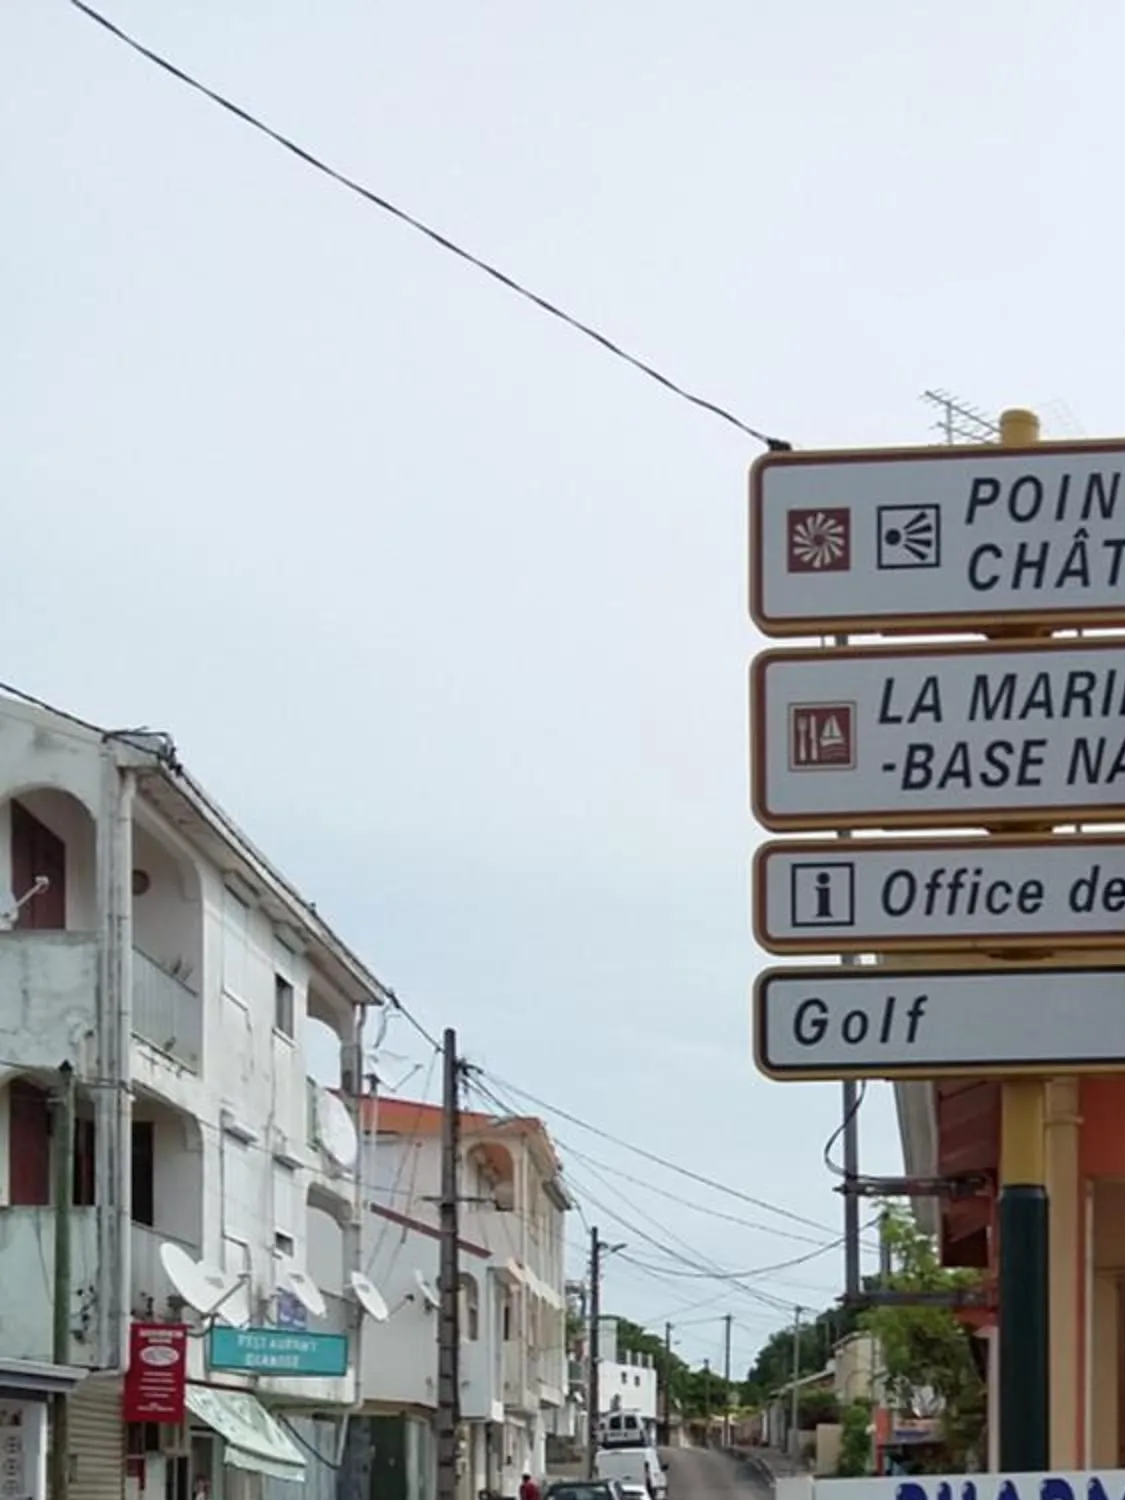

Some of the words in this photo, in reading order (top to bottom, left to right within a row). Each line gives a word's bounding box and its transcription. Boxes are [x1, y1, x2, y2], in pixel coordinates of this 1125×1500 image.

[878, 675, 944, 725] LA
[880, 867, 1045, 917] Office
[792, 995, 928, 1046] Golf
